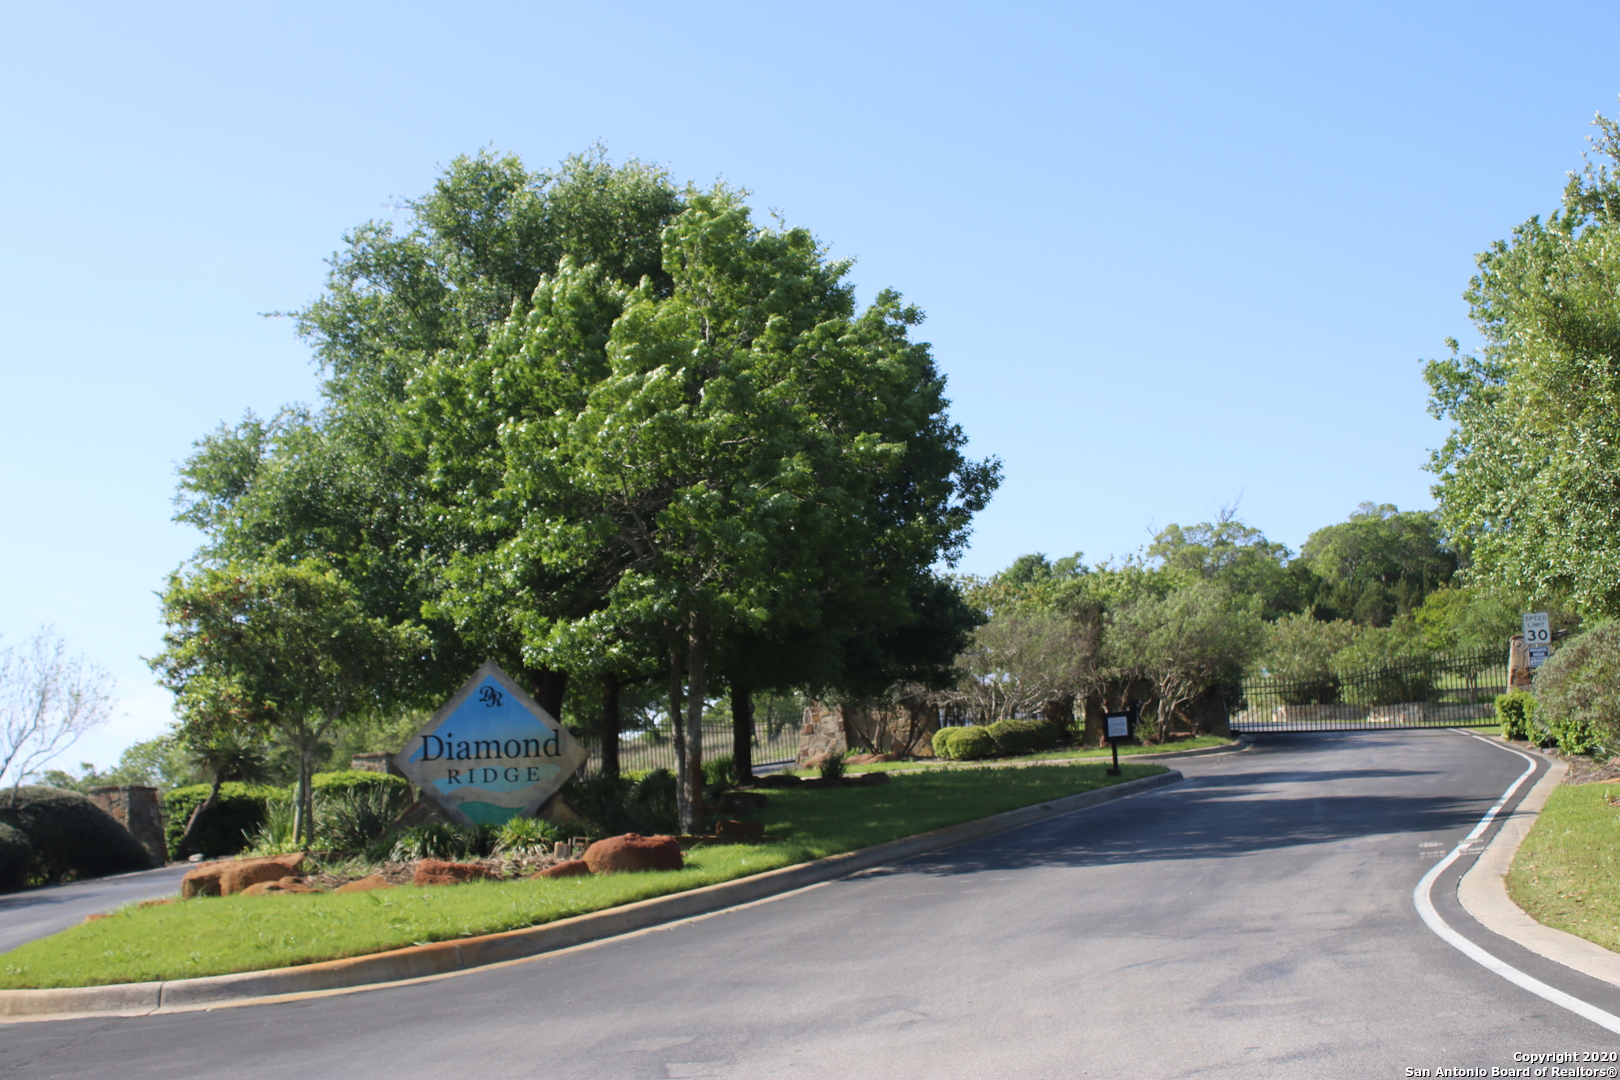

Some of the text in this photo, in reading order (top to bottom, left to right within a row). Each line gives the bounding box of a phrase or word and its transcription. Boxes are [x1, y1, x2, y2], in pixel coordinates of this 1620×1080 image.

[1527, 629, 1548, 641] 30
[420, 729, 561, 761] Diamond
[446, 767, 540, 784] RIDGE
